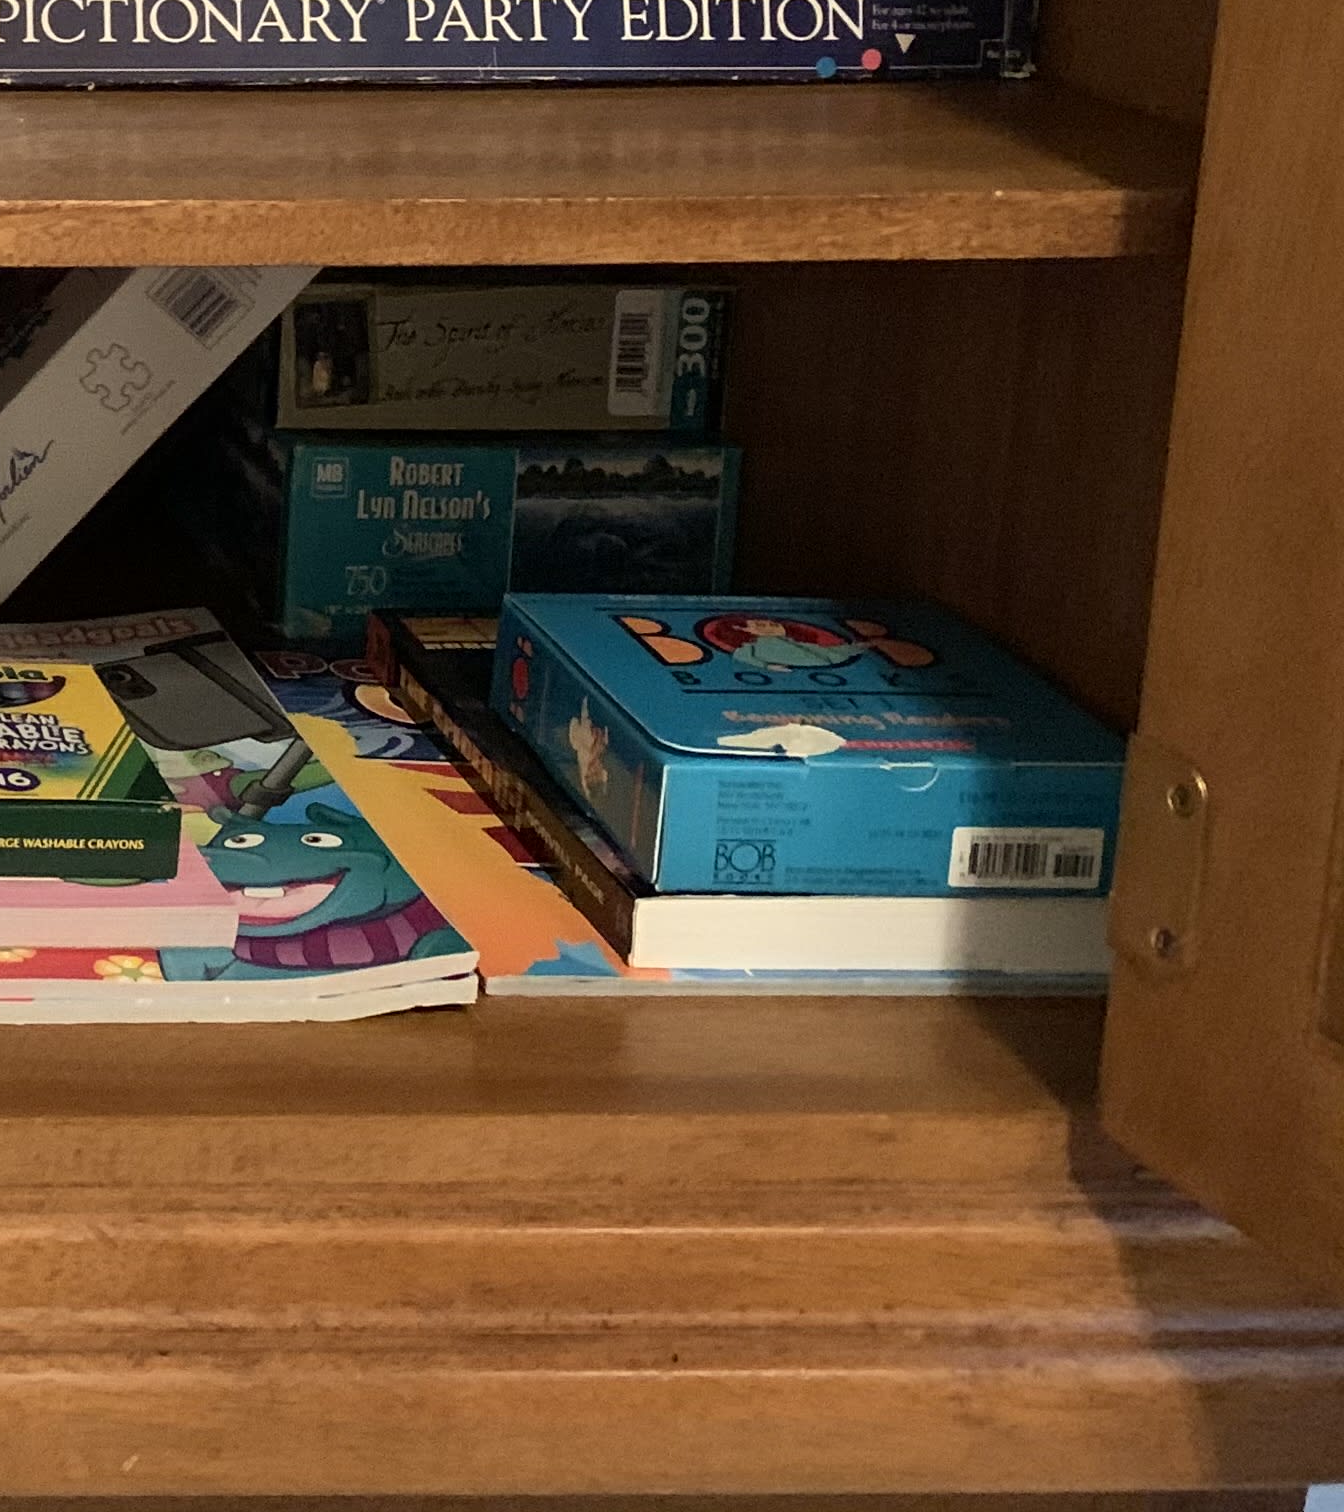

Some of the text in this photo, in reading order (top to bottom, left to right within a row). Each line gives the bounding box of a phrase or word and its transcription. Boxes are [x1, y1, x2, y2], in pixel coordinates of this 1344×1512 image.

[316, 463, 344, 482] MB
[345, 565, 388, 596] 750
[22, 838, 86, 850] WASHABLE
[87, 838, 145, 851] CRAYONS
[714, 841, 777, 871] BOB
